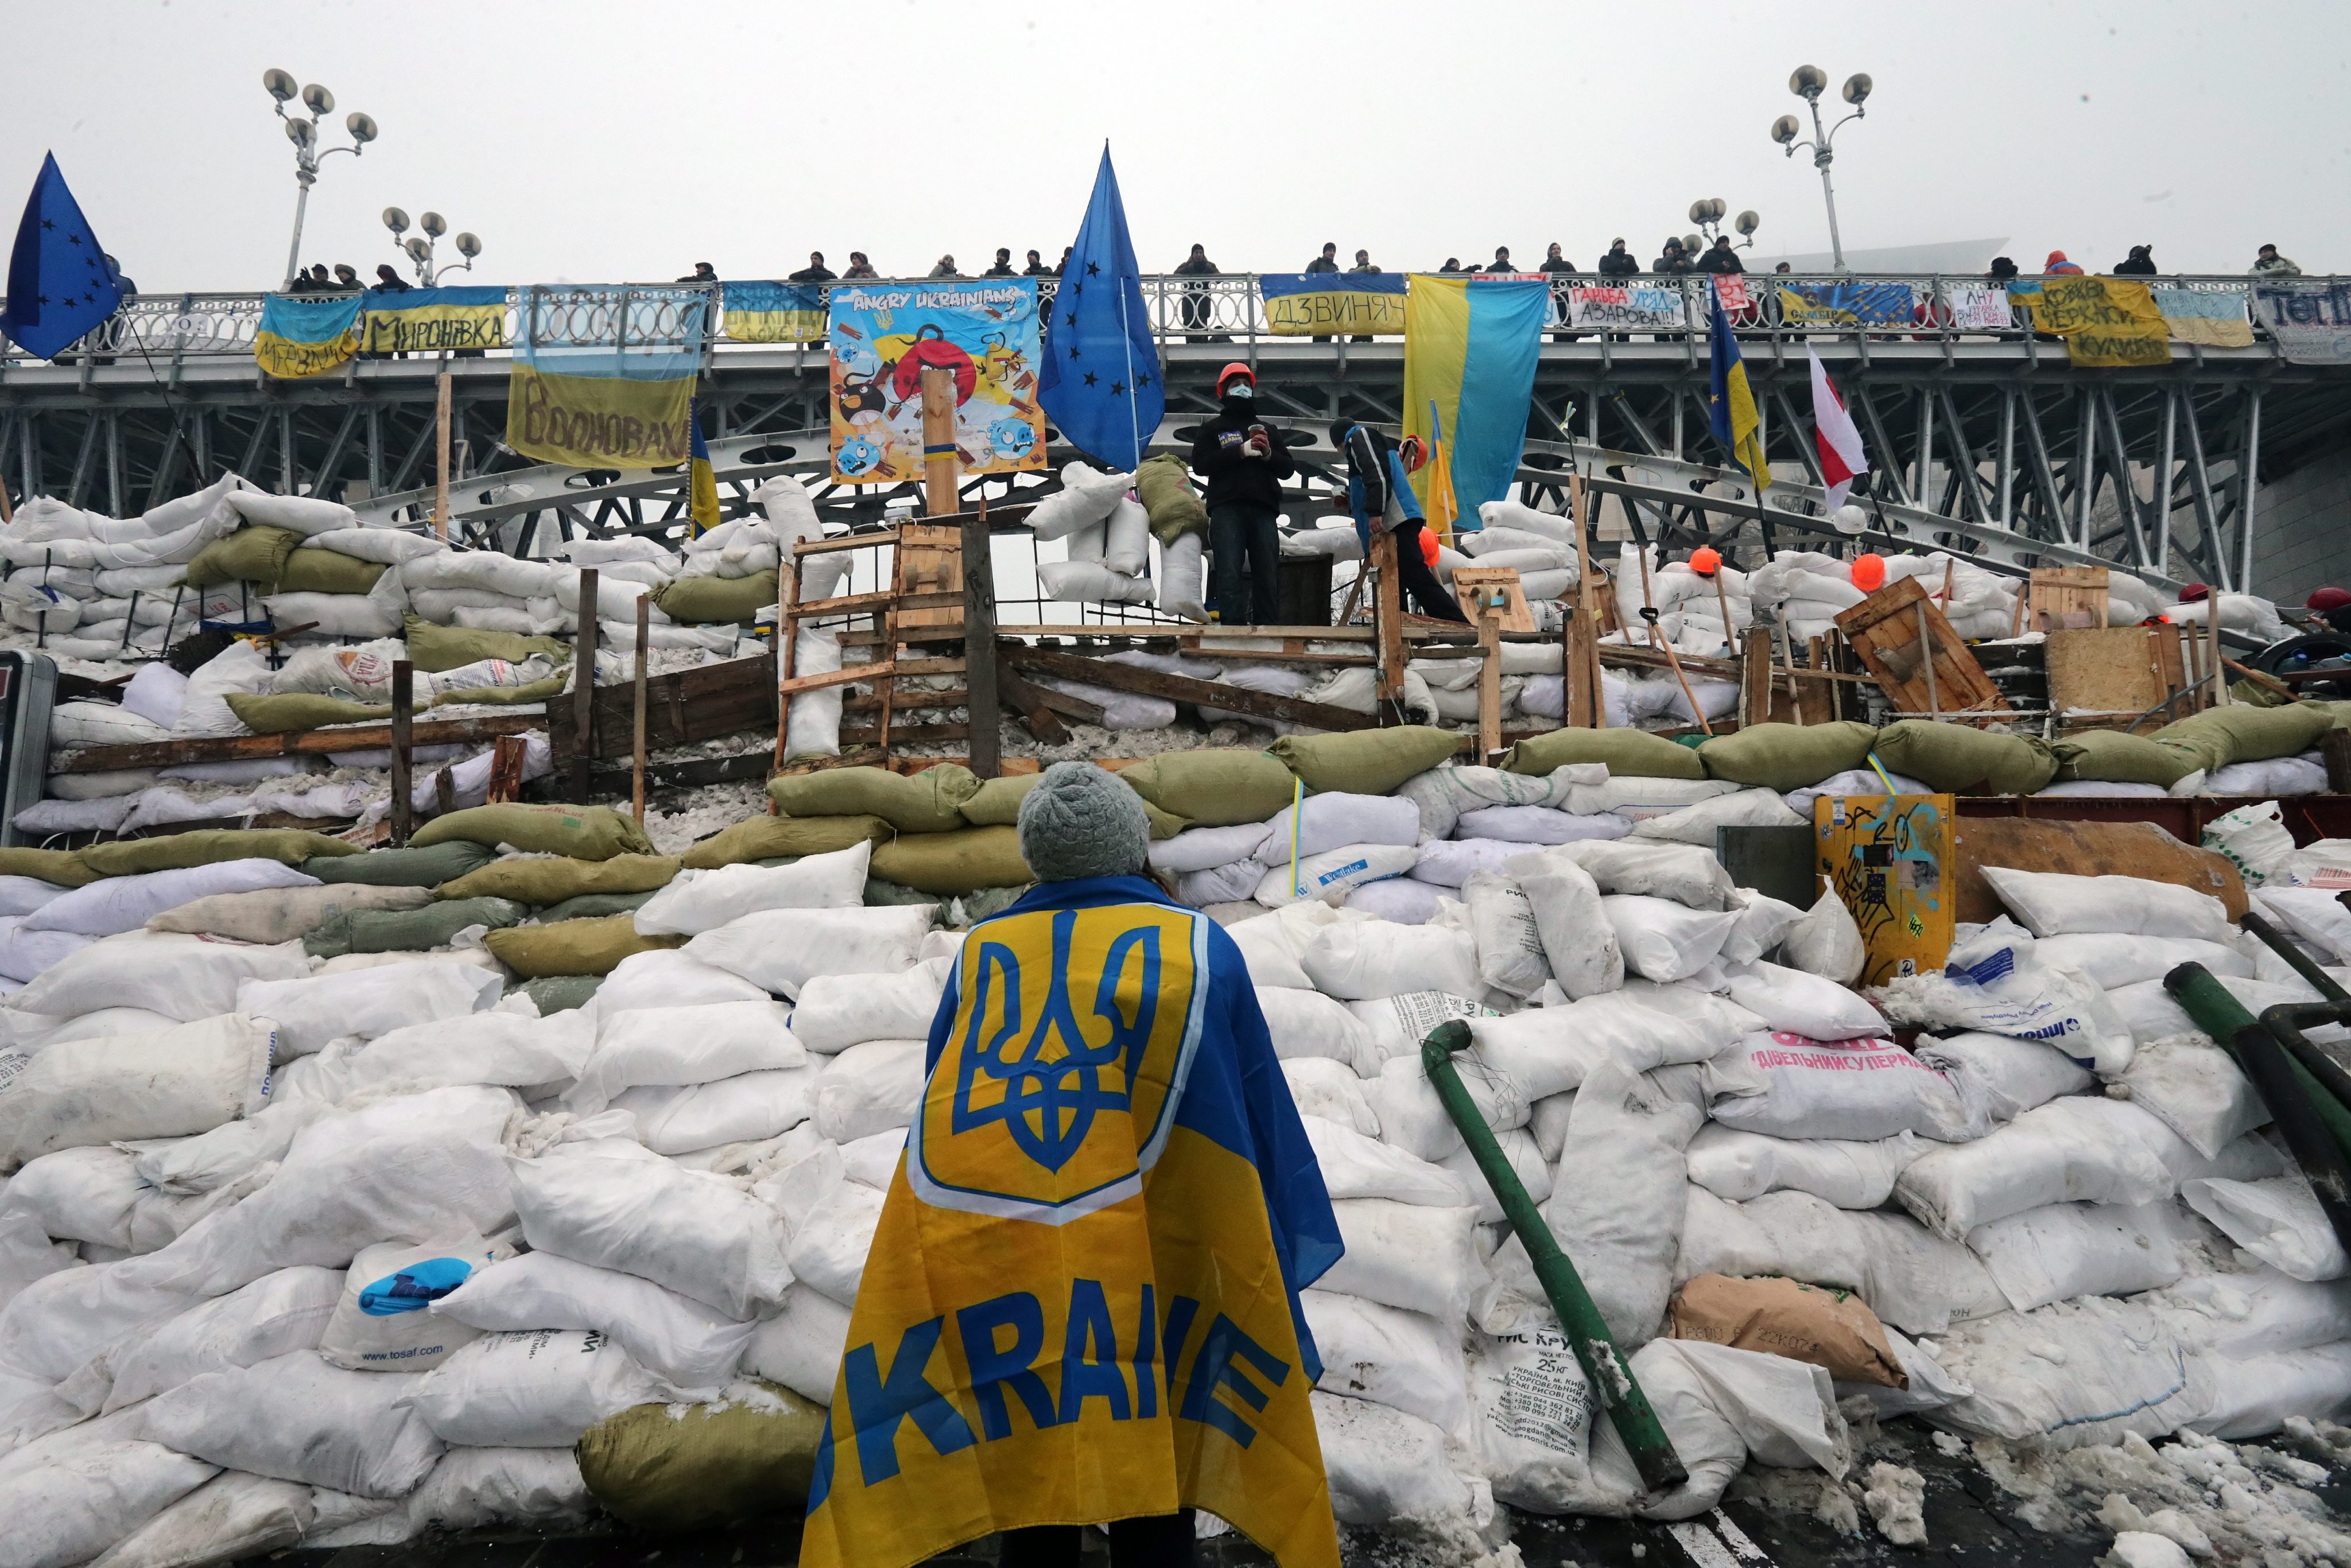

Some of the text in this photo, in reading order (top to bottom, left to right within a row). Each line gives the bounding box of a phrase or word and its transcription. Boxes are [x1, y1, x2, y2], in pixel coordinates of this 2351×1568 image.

[853, 286, 1016, 312] ANGRY UKRAINIANS
[1572, 288, 1628, 304] ГАНЬБА
[1273, 294, 1406, 327] ДЗВИНЯЧ
[1580, 303, 1675, 325] АЗАРОВА!!!
[1324, 863, 1361, 883] Westlake
[362, 1345, 443, 1361] www.tosaf.com
[1550, 1401, 1563, 1410] 362
[1565, 1407, 1573, 1415] 81
